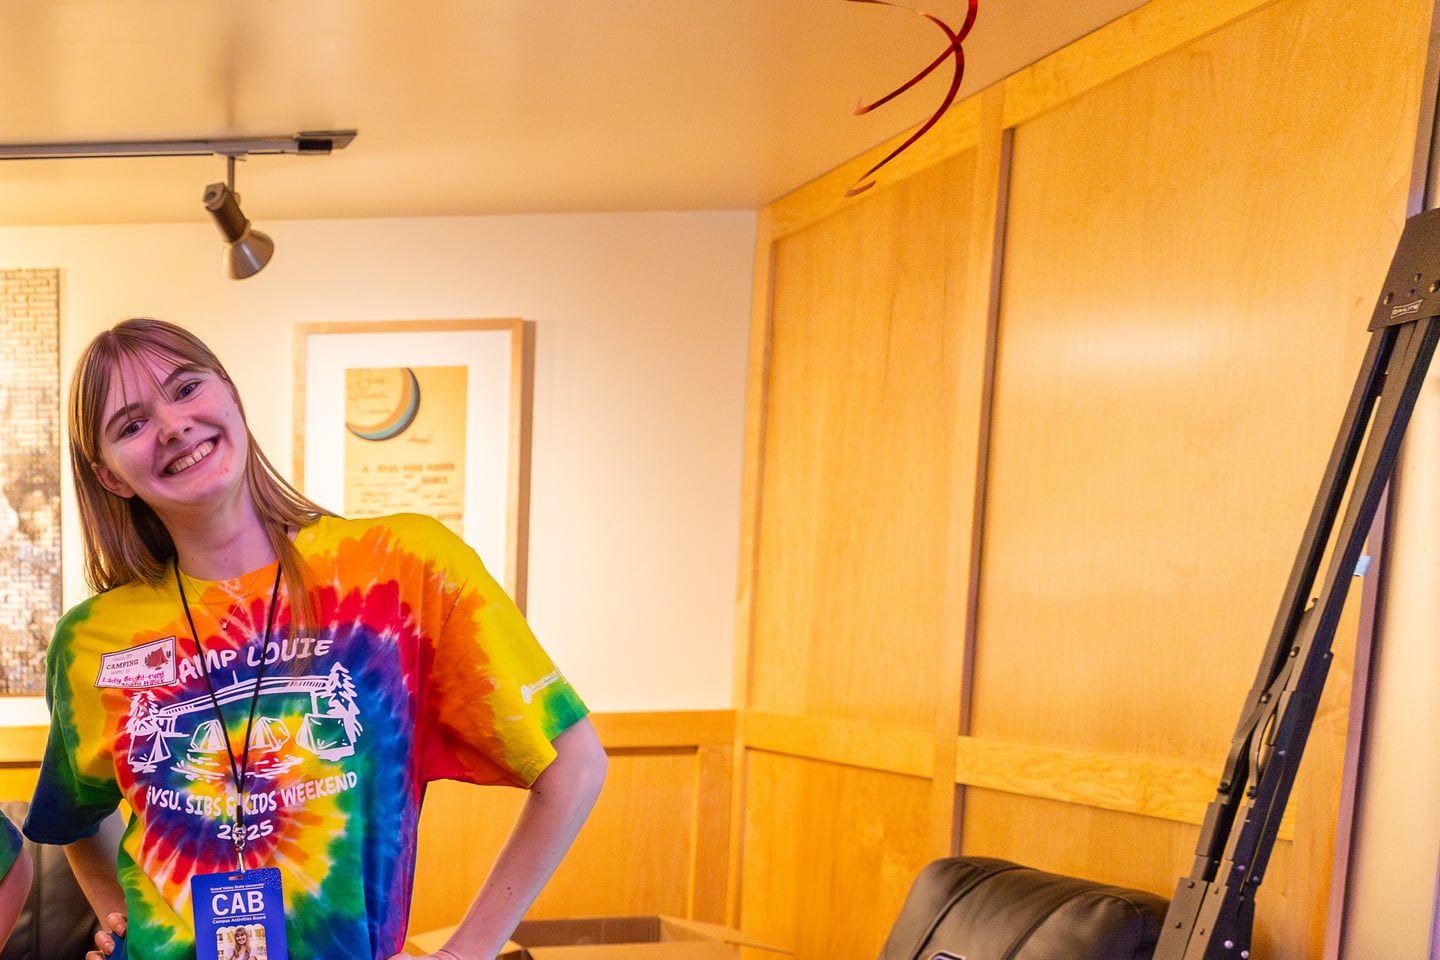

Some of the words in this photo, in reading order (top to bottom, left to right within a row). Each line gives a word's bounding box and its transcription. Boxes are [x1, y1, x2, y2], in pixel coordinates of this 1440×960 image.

[106, 659, 139, 670] CAMPING
[168, 648, 238, 687] AMP
[246, 638, 334, 667] LOUIE
[186, 794, 222, 817] SIBS
[242, 790, 277, 816] KIDS
[280, 771, 358, 808] WEEKEND
[211, 890, 265, 916] CAB
